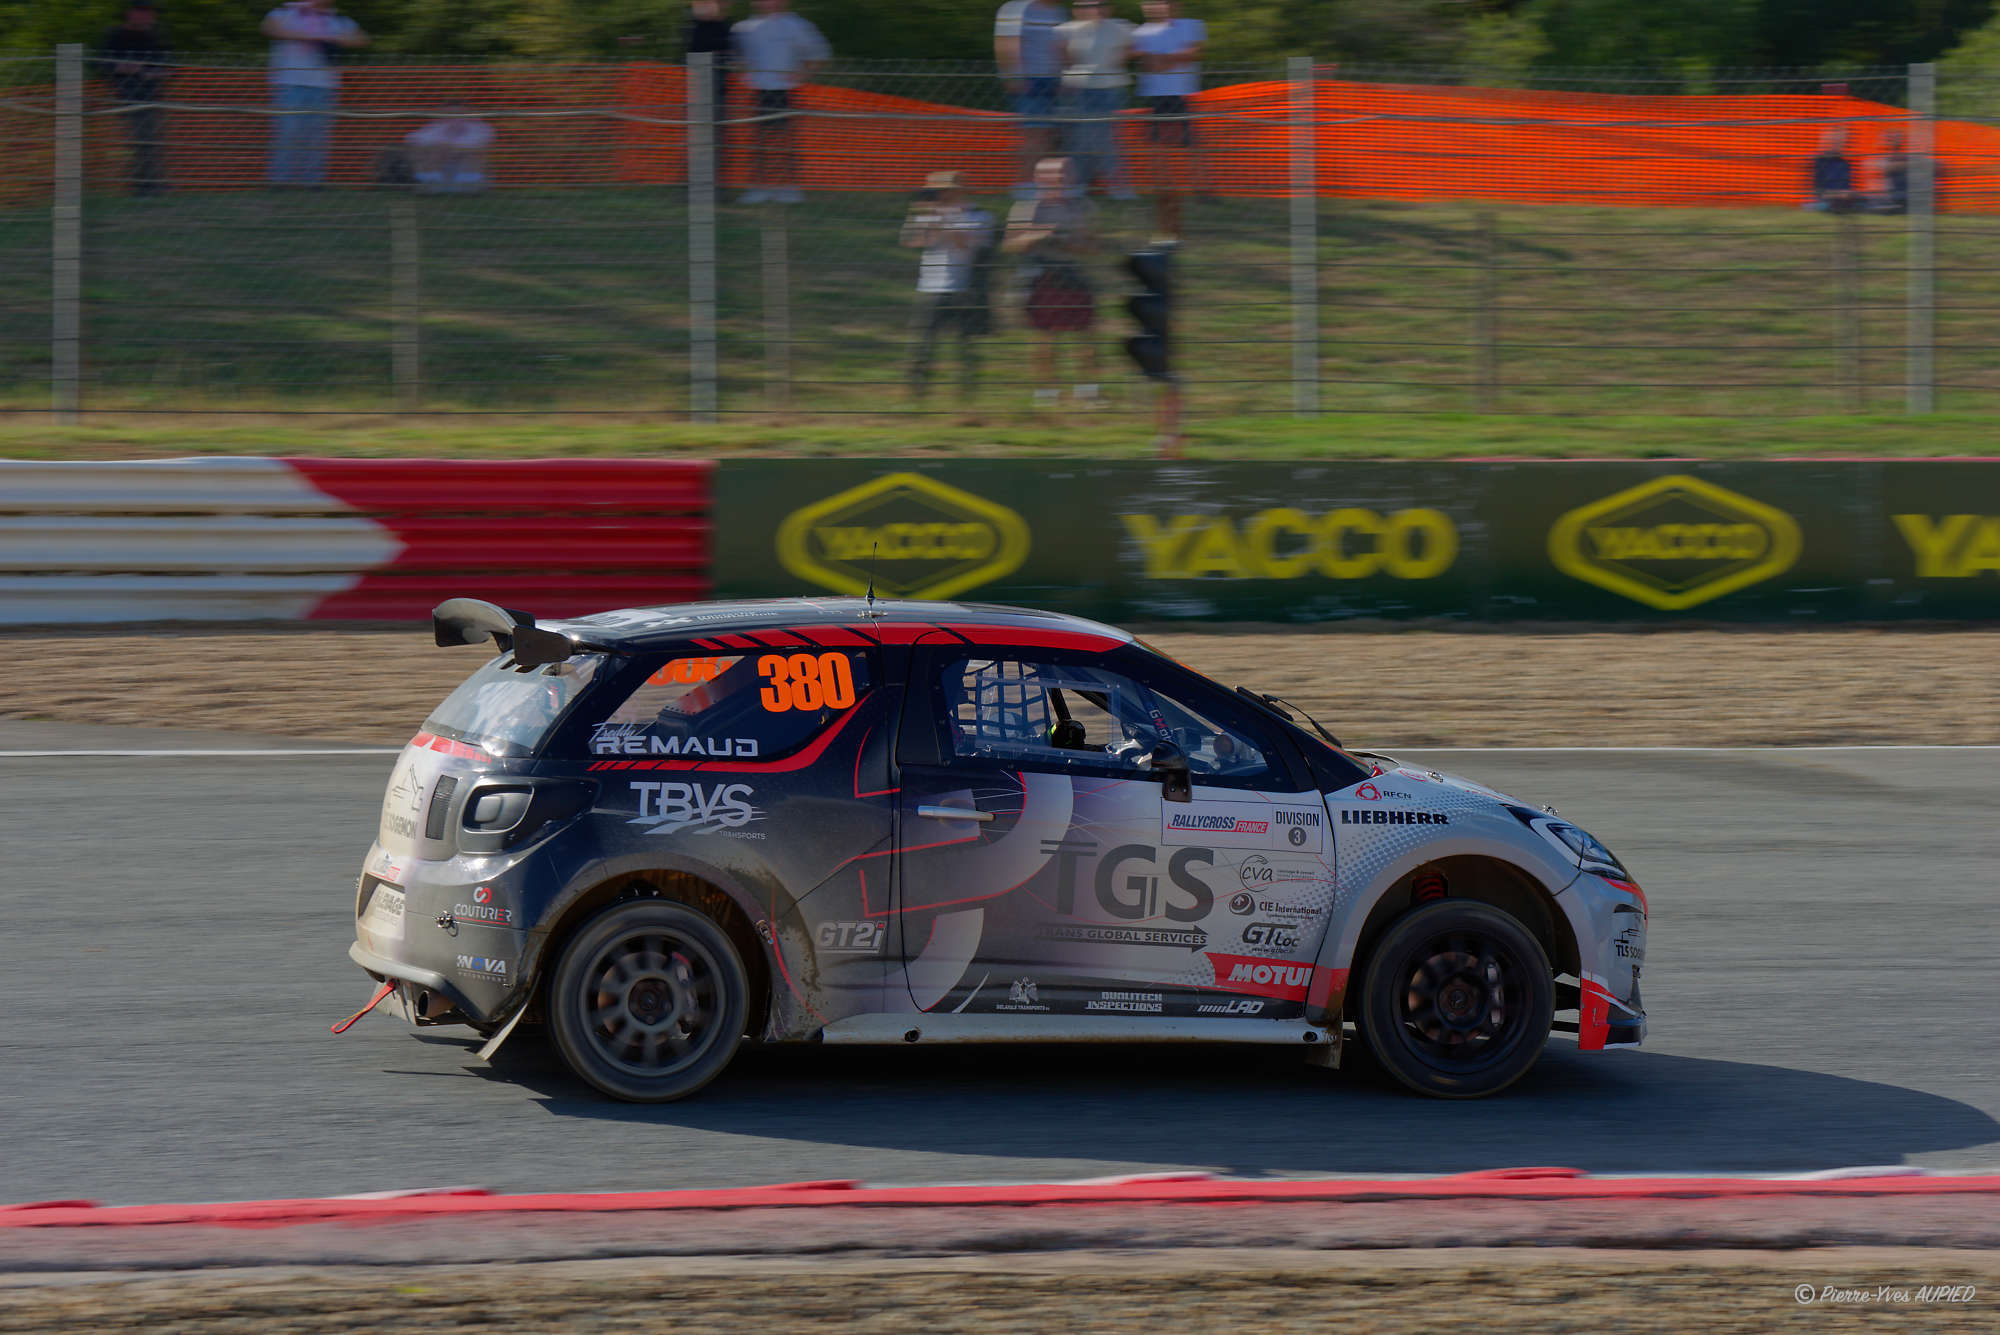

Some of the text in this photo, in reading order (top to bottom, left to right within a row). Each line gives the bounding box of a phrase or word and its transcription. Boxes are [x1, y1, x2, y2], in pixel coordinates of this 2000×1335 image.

[815, 522, 998, 560] YACCO
[1121, 507, 1459, 580] YACCO
[1587, 523, 1769, 559] YACCO
[757, 652, 856, 713] 380
[596, 735, 759, 757] REMAUD
[630, 781, 755, 827] TBVS
[1172, 814, 1267, 833] RALLYCROSS FRANCE
[1275, 811, 1320, 827] DIVISION
[1341, 810, 1449, 825] LIEBHERR
[719, 830, 767, 840] TRANSPORTS
[1293, 829, 1301, 844] 3
[1040, 839, 1215, 923] TGS
[454, 903, 512, 922] COUTURIER
[1259, 901, 1322, 915] CIE International
[816, 922, 885, 948] GT2i
[1087, 929, 1141, 941] GLOBAL
[1144, 932, 1207, 944] SERVICES
[1615, 944, 1629, 958] TLS
[1087, 1000, 1163, 1012] INSPECTIONS
[1226, 999, 1265, 1014] LAD
